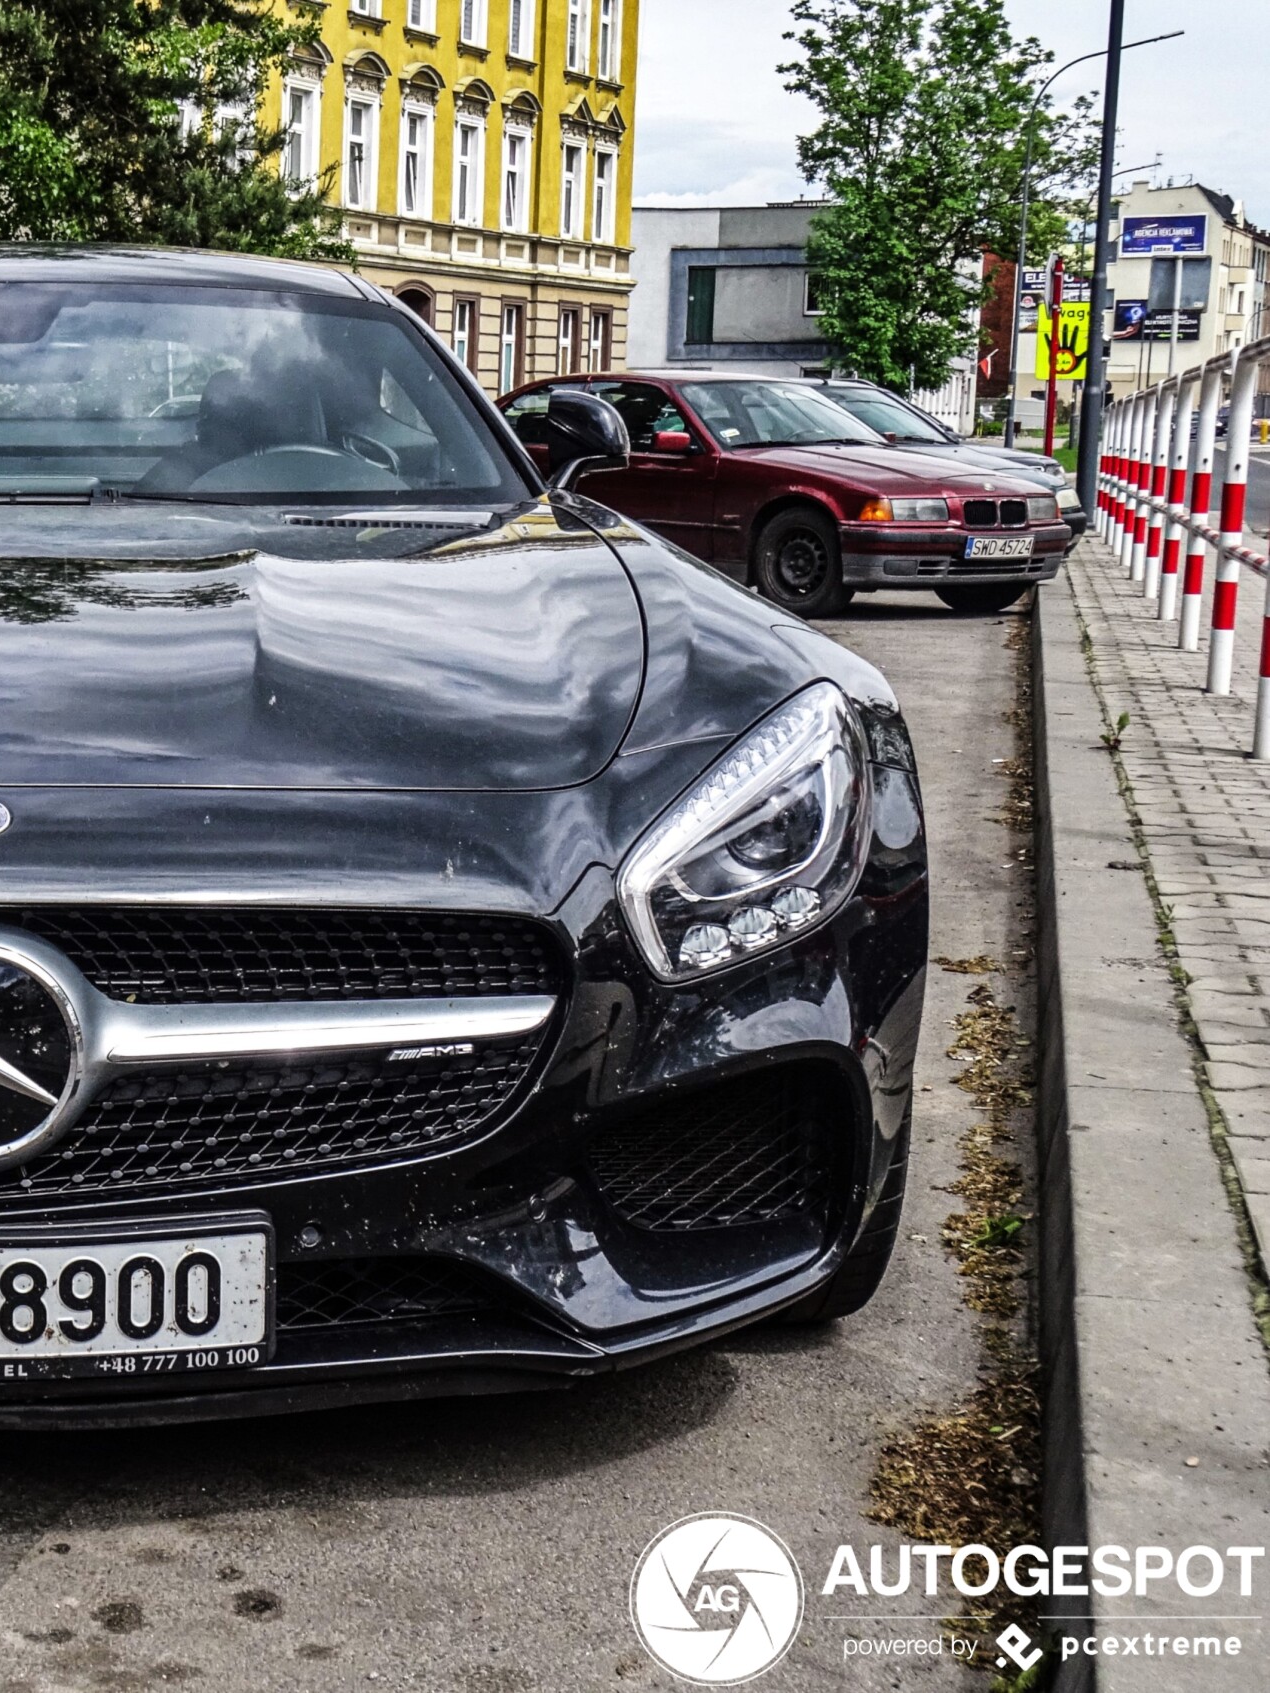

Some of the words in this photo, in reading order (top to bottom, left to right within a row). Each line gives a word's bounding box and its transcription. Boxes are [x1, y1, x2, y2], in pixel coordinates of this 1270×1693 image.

[972, 540, 998, 555] SWD
[999, 539, 1032, 555] 45724
[99, 1355, 136, 1373] +48
[142, 1354, 177, 1372] 777
[186, 1351, 219, 1369] 100
[226, 1347, 260, 1366] 100
